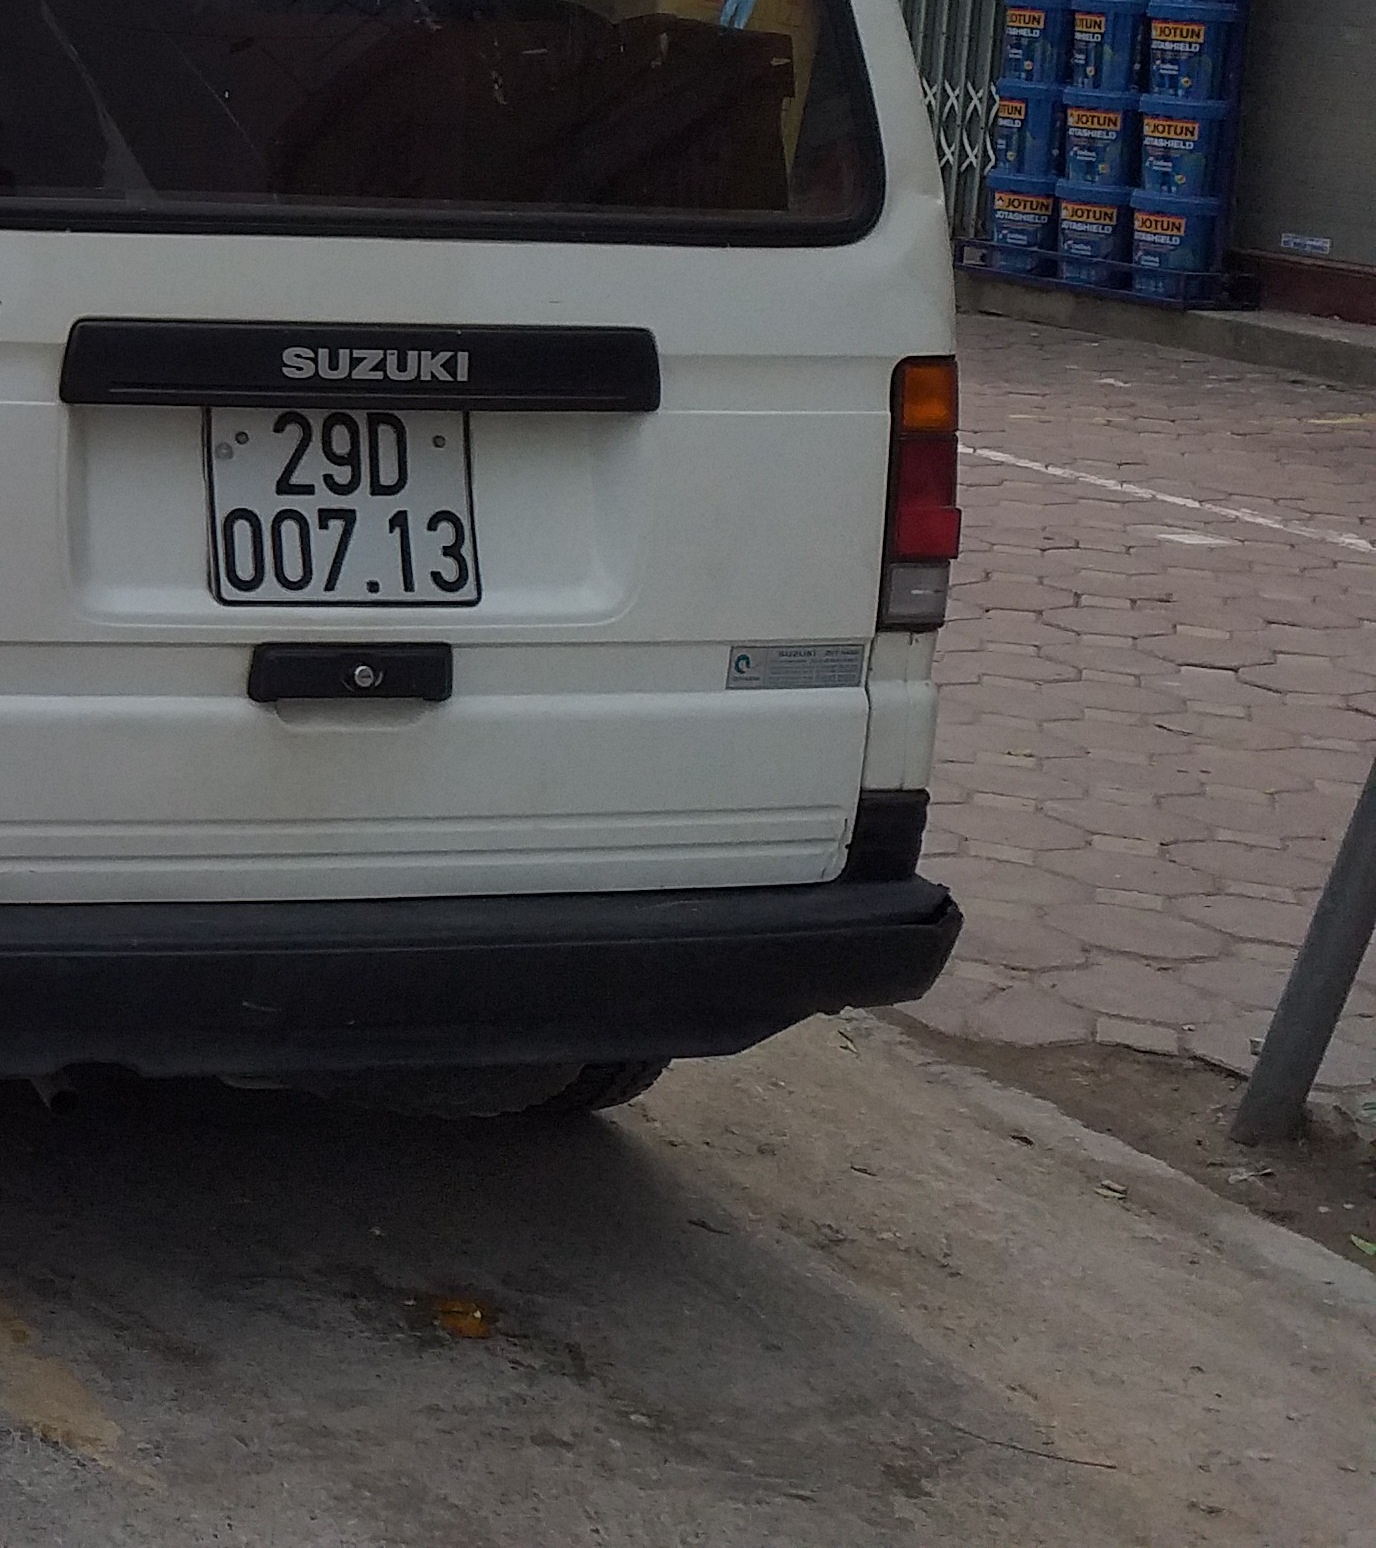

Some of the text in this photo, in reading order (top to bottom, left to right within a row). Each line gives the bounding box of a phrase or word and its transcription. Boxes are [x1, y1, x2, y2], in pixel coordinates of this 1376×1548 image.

[1158, 25, 1203, 40] JOTUN
[1075, 113, 1119, 128] JOTUN
[1150, 123, 1196, 138] JOTUN
[1006, 197, 1050, 212] JOTUN
[1069, 205, 1114, 222] JOTUN
[1140, 216, 1182, 233] JOTUN
[281, 347, 469, 382] SUZUKI
[272, 411, 408, 496] 29D
[222, 507, 469, 594] 007.13
